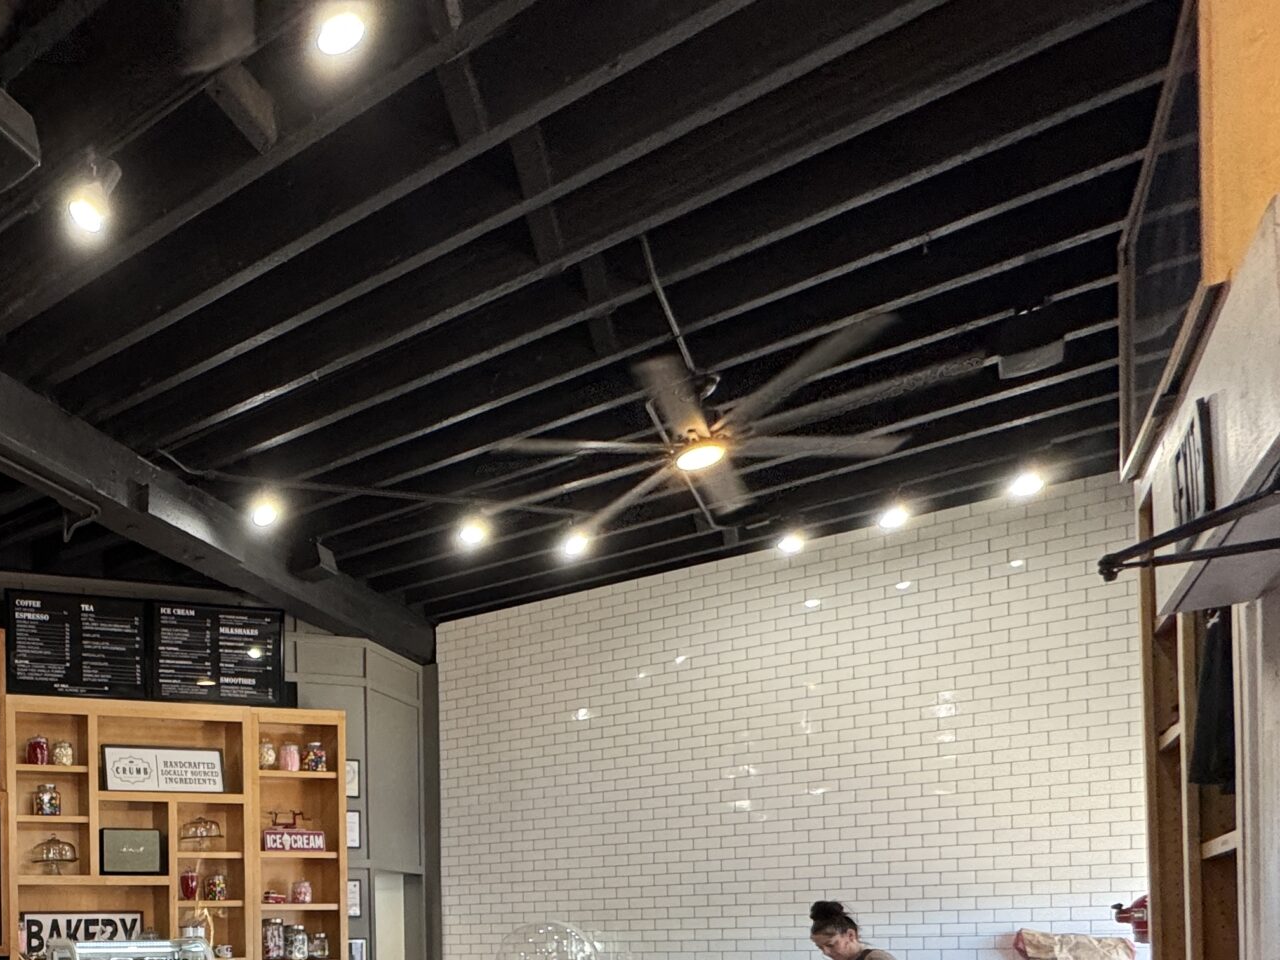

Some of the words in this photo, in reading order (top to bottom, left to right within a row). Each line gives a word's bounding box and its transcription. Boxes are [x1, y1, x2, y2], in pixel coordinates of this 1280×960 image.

[15, 599, 41, 608] COFFEE
[80, 604, 94, 612] TEA
[160, 607, 172, 615] ICE
[173, 608, 195, 616] CREAM
[15, 612, 49, 621] ESPRESSO
[219, 627, 259, 636] MILKSHAKES
[220, 677, 256, 686] SMOOTHIES
[163, 760, 216, 770] HANDCRAFTED
[115, 766, 149, 776] CRUMB
[161, 769, 188, 777] LOCALLY
[190, 770, 219, 778] SOURCED
[164, 777, 217, 785] INGREDIENTS
[266, 834, 283, 849] ICE
[291, 834, 324, 849] CREAM
